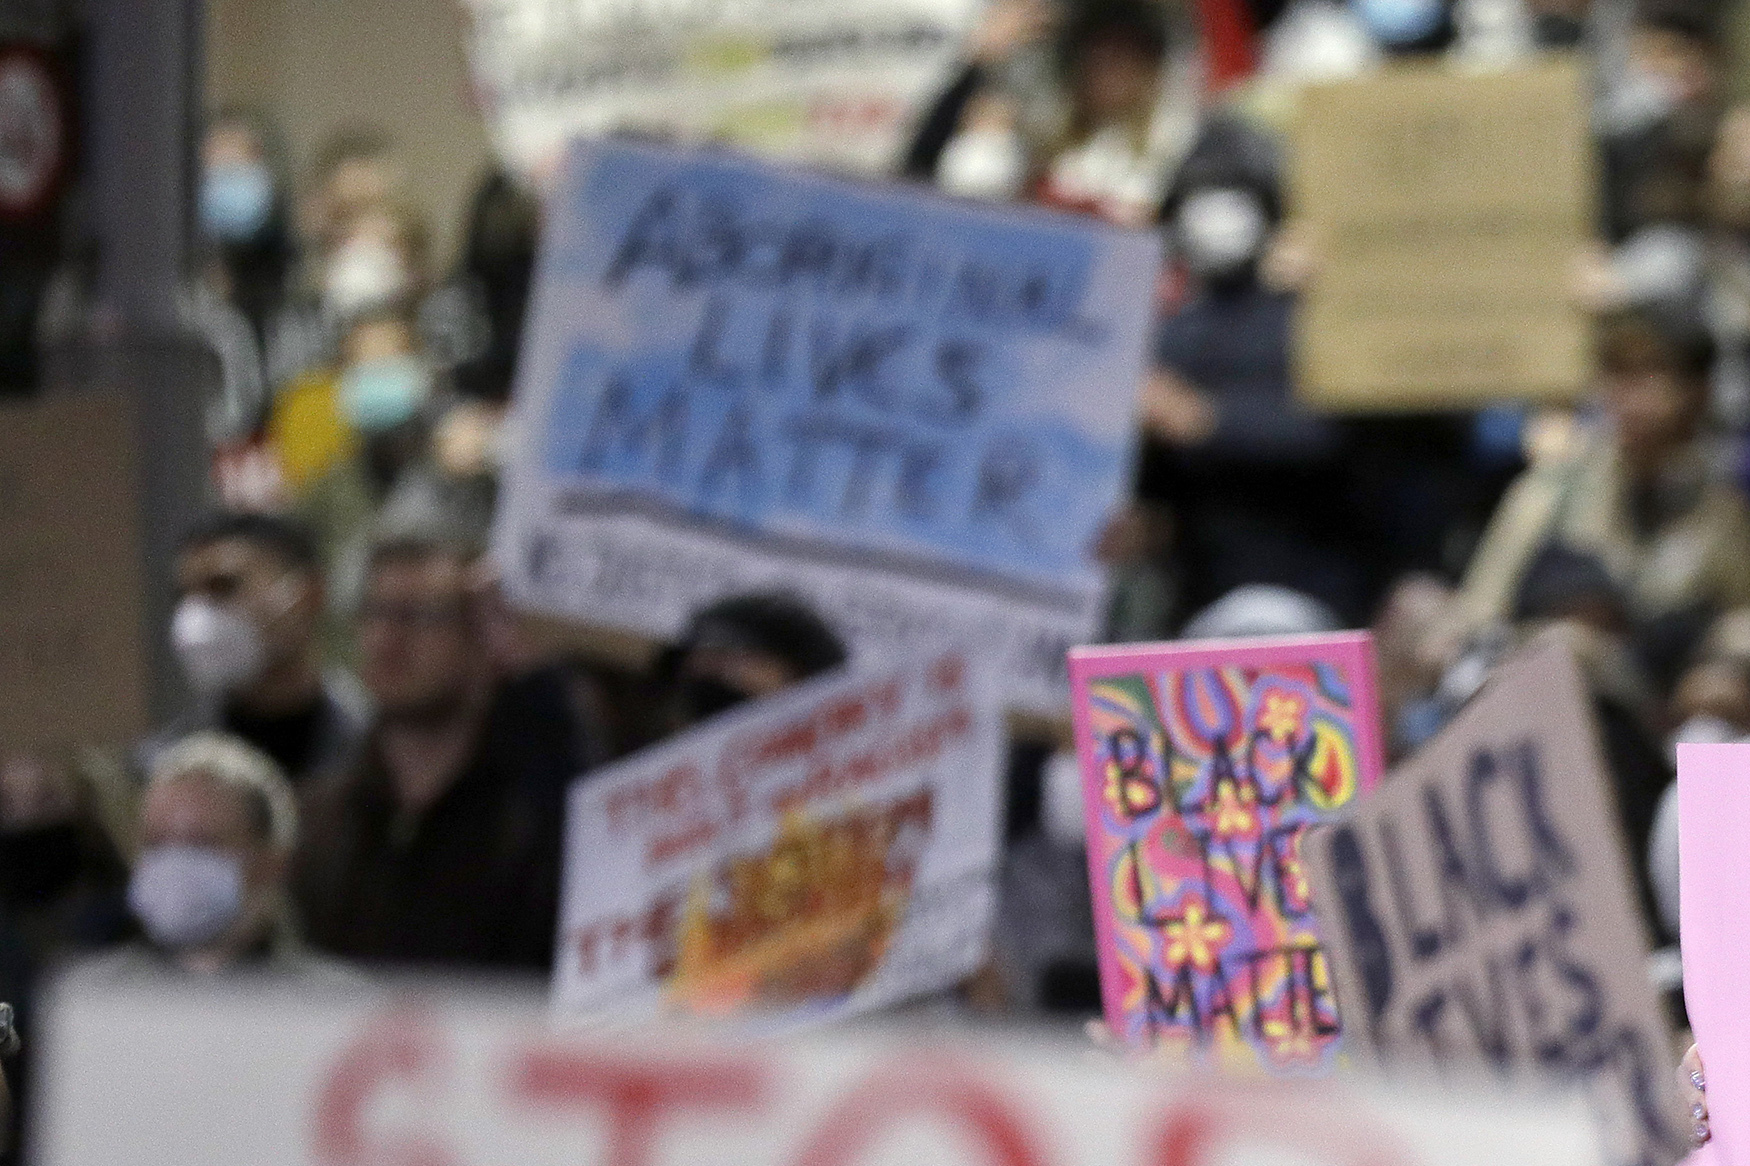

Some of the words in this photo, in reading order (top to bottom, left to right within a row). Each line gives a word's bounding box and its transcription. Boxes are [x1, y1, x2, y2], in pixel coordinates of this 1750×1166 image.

[576, 370, 1040, 556] MATTER
[1103, 724, 1336, 820] BLACK
[1125, 820, 1312, 928] LIVE
[1140, 943, 1342, 1050] MATTE
